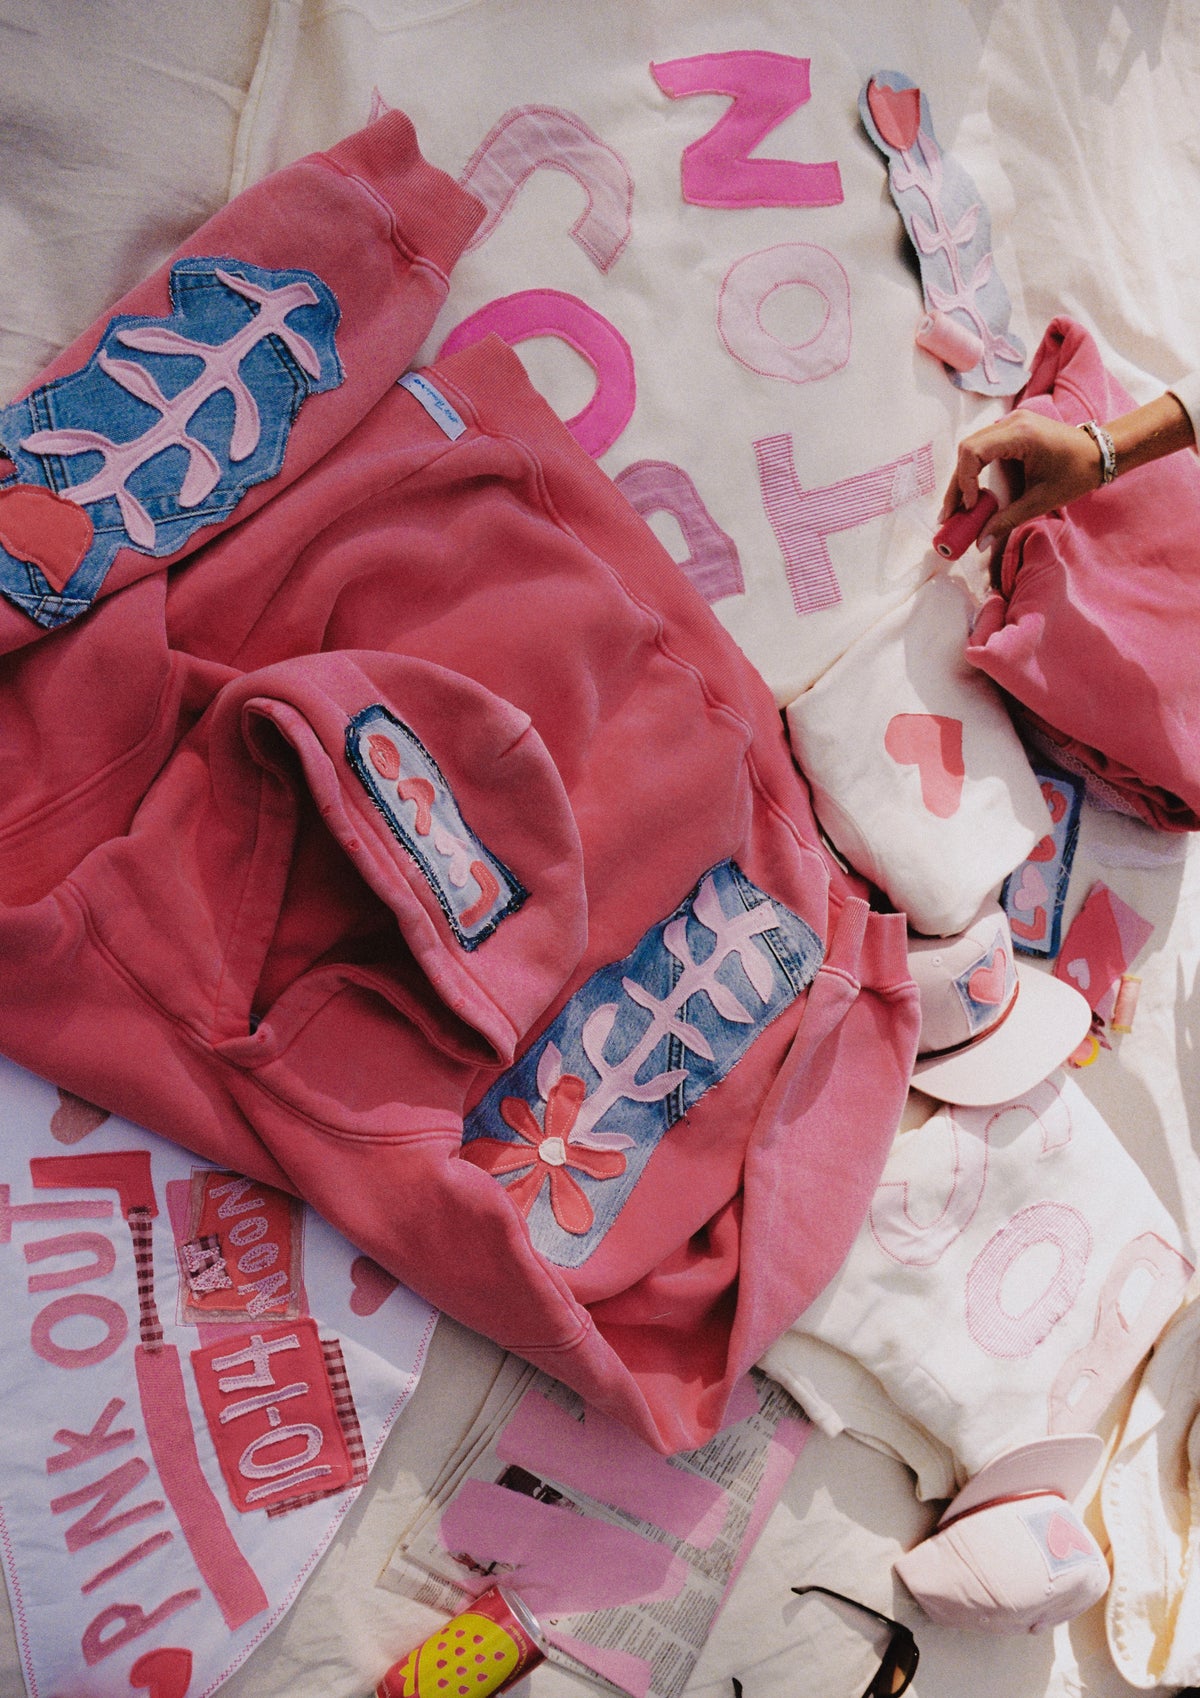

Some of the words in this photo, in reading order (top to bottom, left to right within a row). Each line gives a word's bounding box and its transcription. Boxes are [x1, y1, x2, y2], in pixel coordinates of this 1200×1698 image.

[650, 49, 936, 615] TON
[0, 1183, 129, 1370] OUT
[182, 1241, 234, 1295] AT
[208, 1179, 299, 1318] NOON
[211, 1333, 332, 1504] 10-14
[46, 1396, 201, 1667] PINK
